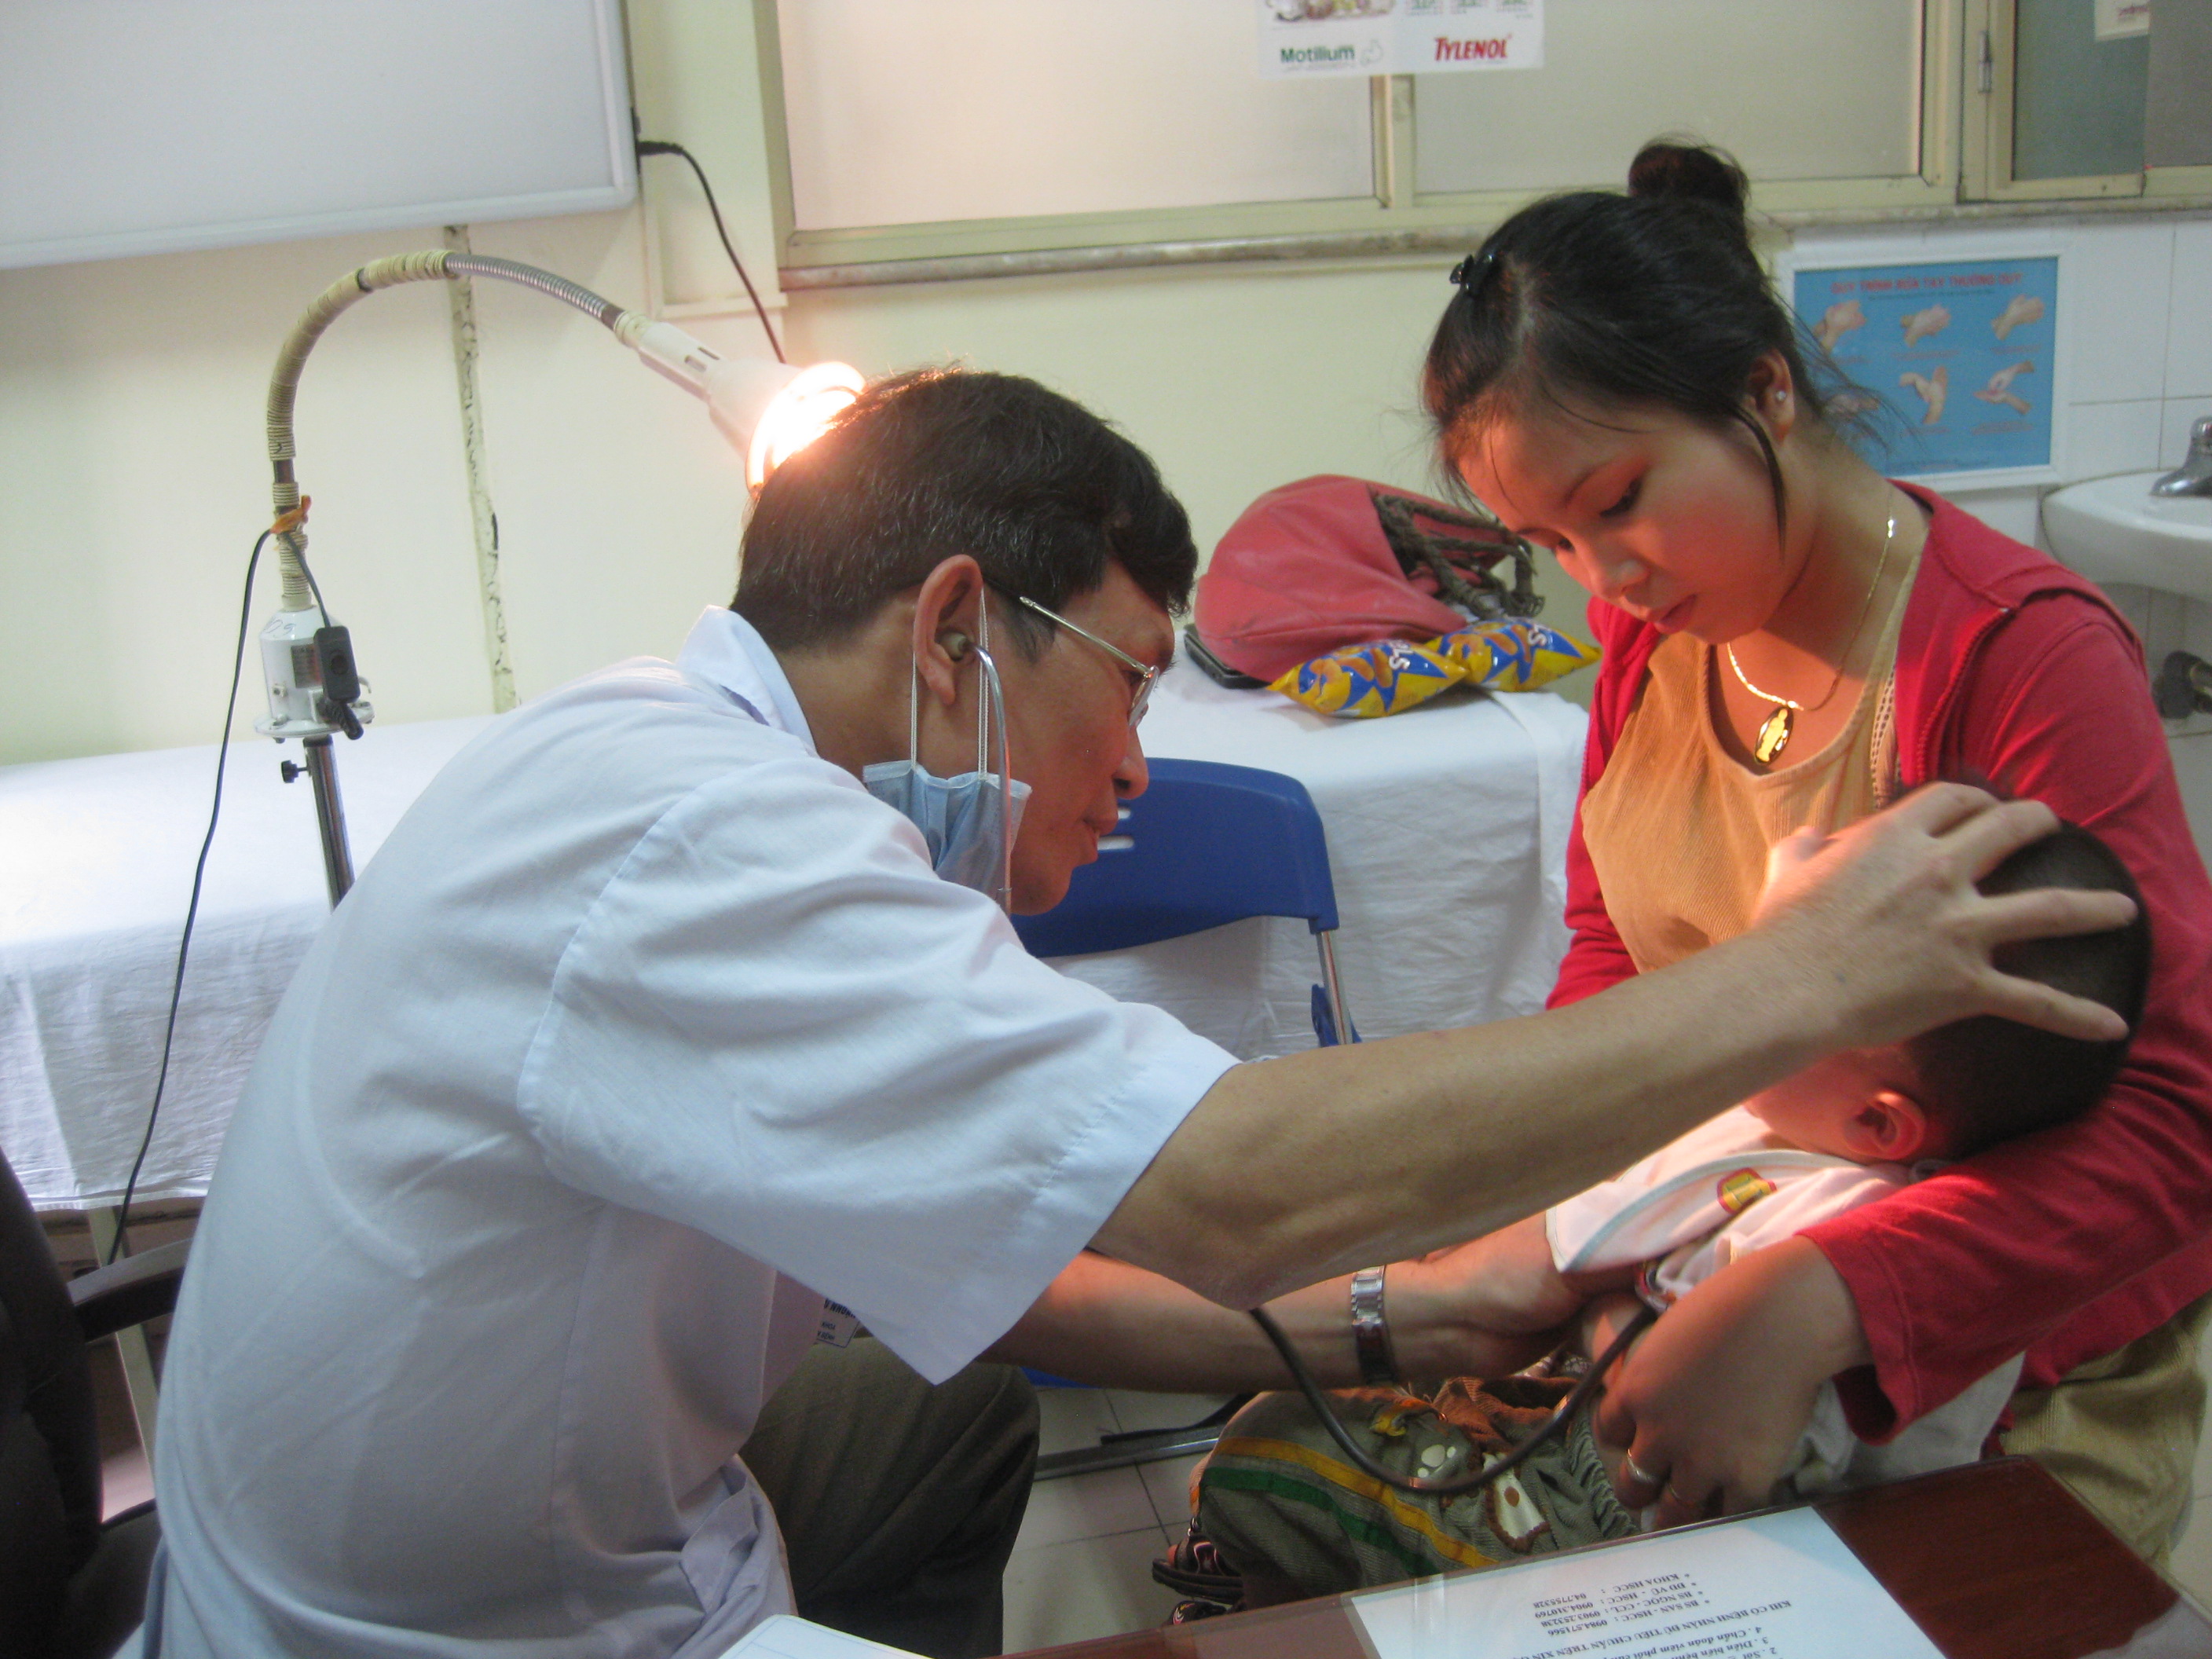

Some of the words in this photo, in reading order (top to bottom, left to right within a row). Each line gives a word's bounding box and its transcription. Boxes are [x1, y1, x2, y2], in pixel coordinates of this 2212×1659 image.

[1434, 36, 1507, 61] TYLENOL
[1644, 1573, 1680, 1585] KHOA
[1613, 1580, 1644, 1593] HSCC
[1608, 1592, 1639, 1604] HSCC
[1768, 1600, 1792, 1611] KHI
[1622, 1610, 1654, 1622] HSCC
[1762, 1636, 1769, 1645] 3
